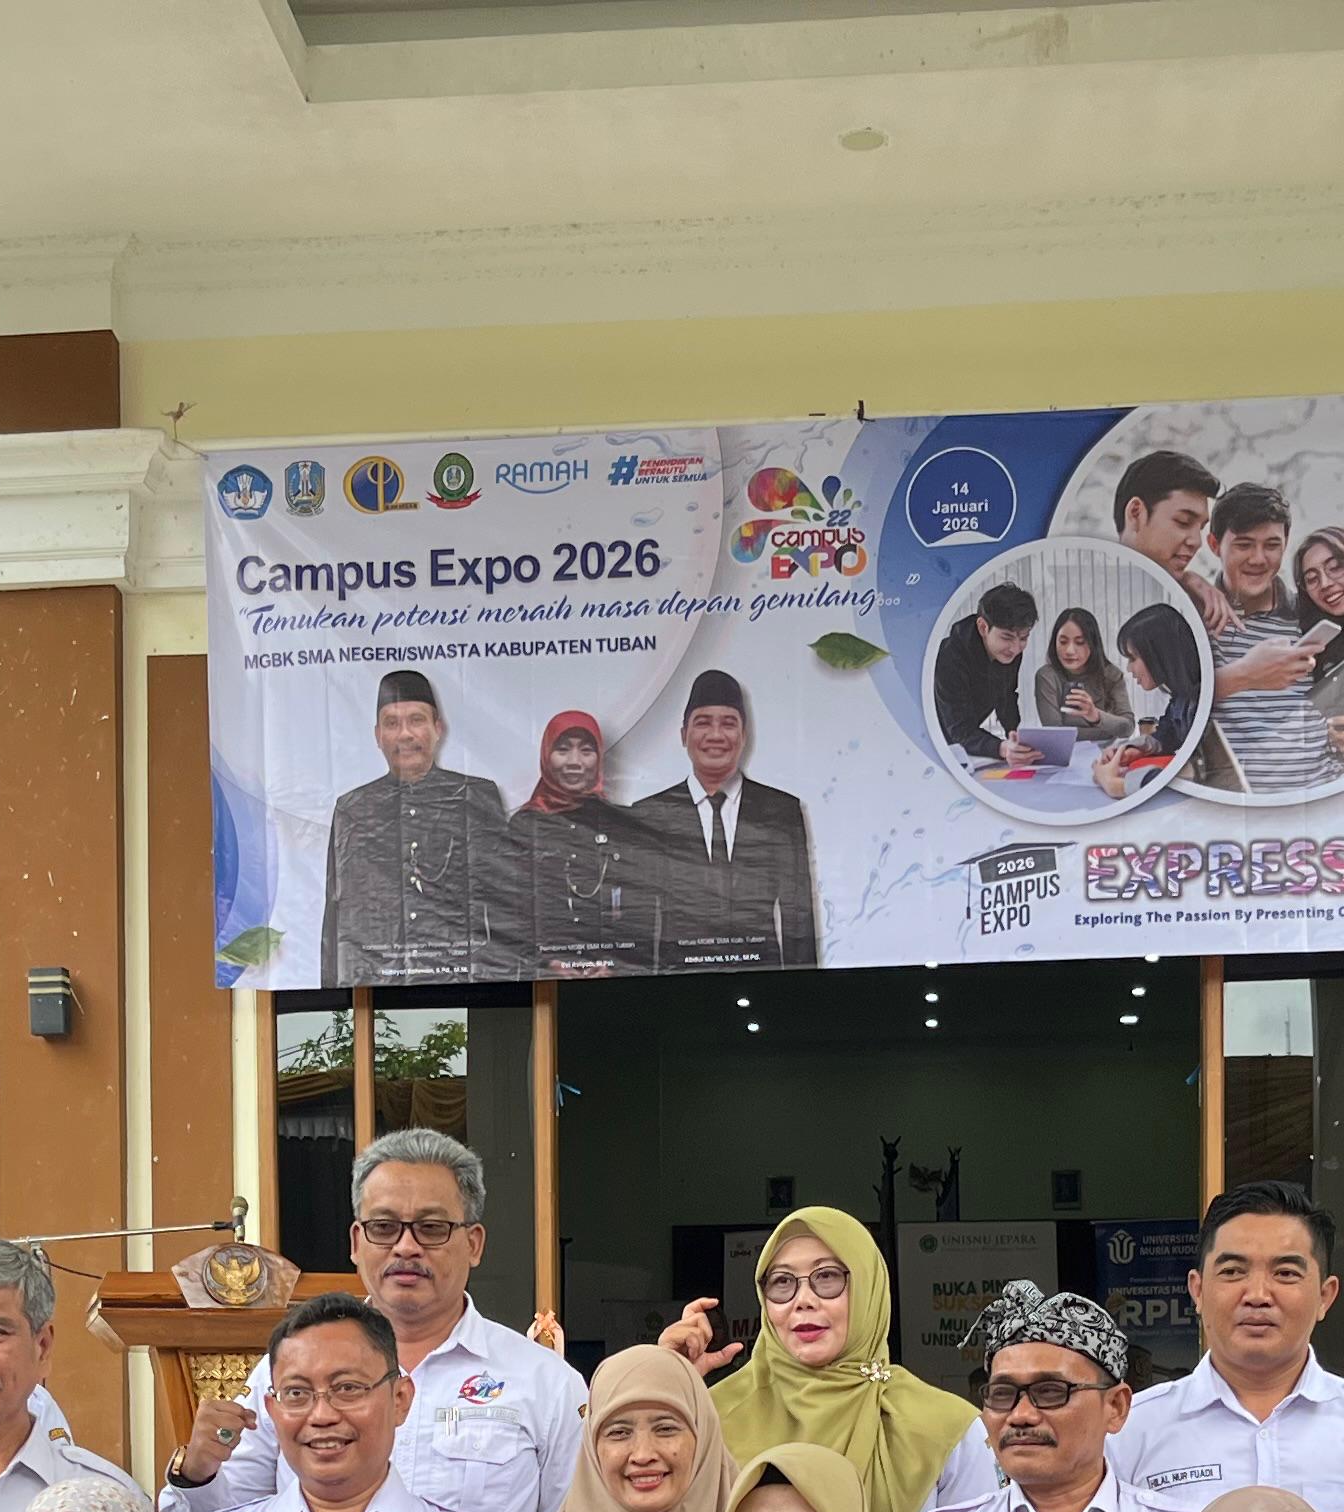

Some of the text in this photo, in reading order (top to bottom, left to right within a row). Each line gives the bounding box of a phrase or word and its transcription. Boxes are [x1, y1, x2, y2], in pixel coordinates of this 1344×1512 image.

[638, 465, 686, 476] BERMUTU
[640, 456, 703, 468] PENDIDIKAN
[495, 459, 588, 486] RAMAH
[635, 473, 707, 485] UNTUK SEMUA
[951, 482, 969, 496] 14
[932, 499, 989, 514] Januari
[826, 509, 851, 527] 22
[942, 517, 978, 531] 2026
[236, 538, 660, 600] Campus Expo 2026
[771, 545, 867, 579] EXPO
[372, 602, 471, 635] potensi
[477, 594, 570, 624] meraih
[580, 598, 652, 621] masa
[658, 590, 742, 622] depan
[244, 635, 656, 670] MGBK SMA NEGERI/SWASTA KABUPATEN TUBAN
[997, 856, 1035, 875] 2026
[980, 874, 1060, 911] CAMPUS
[980, 904, 1031, 935] EXPO
[1074, 912, 1142, 926] Exploring
[1146, 911, 1172, 923] The
[1176, 909, 1230, 922] Passion
[1235, 909, 1252, 924] By
[1256, 907, 1334, 922] Presenting
[942, 1233, 1036, 1246] UNISNU JEPARA
[1139, 1247, 1171, 1256] MURIA
[933, 1279, 1008, 1297] BUKA PIN
[1108, 1285, 1189, 1296] UNIVERSITAS MU
[1172, 1471, 1188, 1482] NUR
[1190, 1468, 1214, 1479] FUADI
